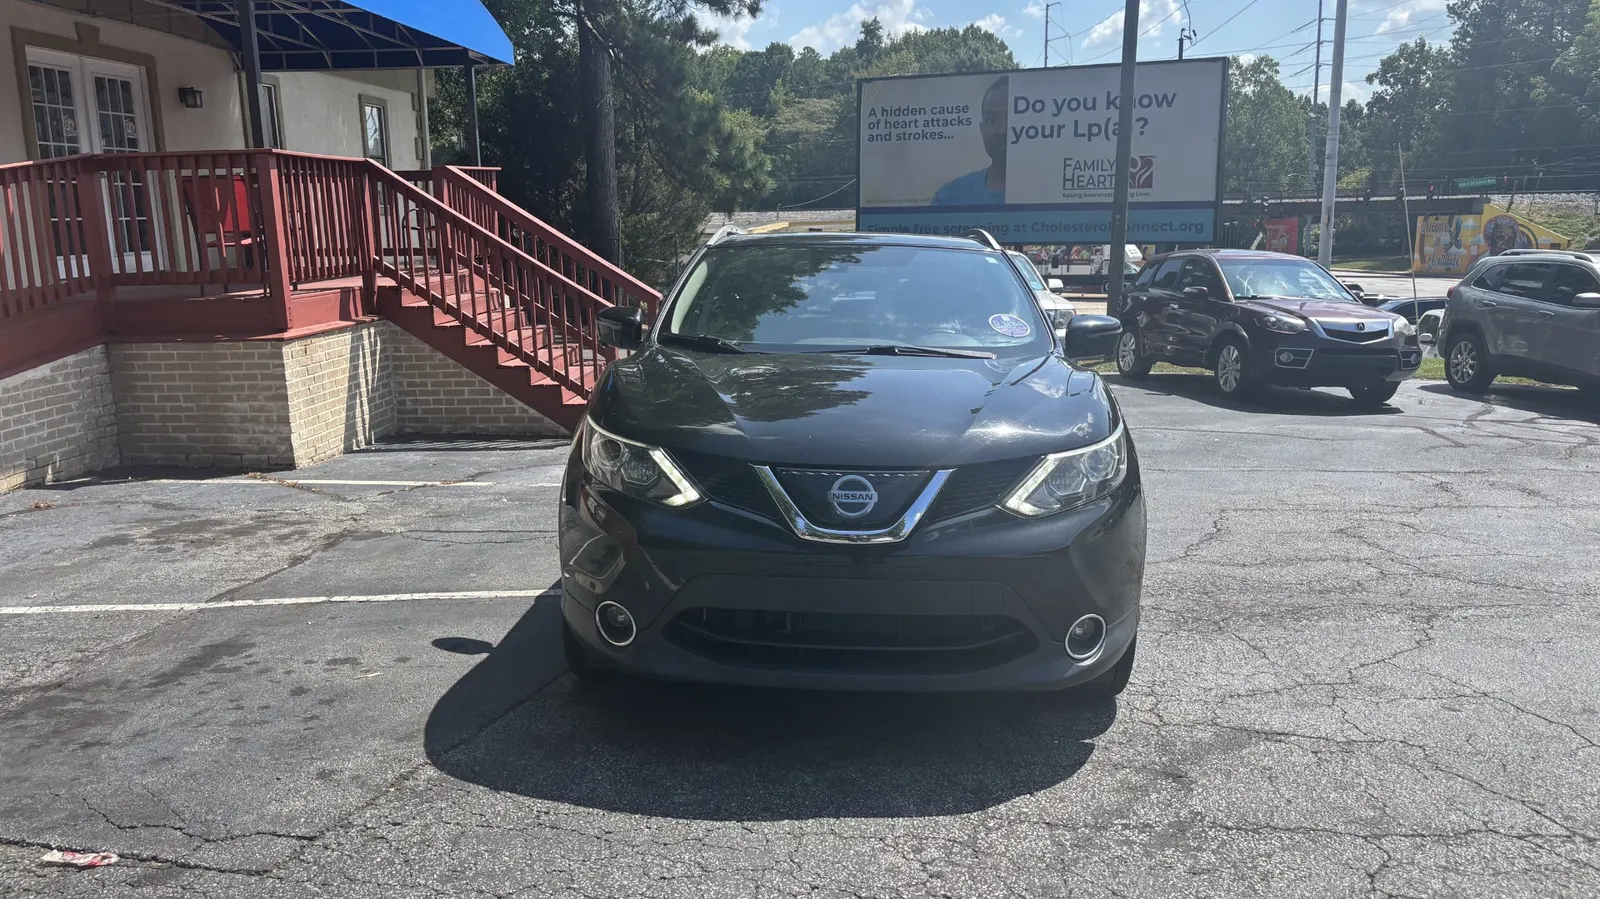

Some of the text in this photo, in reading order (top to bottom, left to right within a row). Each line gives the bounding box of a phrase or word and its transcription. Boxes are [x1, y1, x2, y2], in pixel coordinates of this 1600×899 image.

[868, 104, 970, 118] A hidden cause
[1013, 90, 1177, 117] Do you kow
[868, 115, 972, 130] of heart attacks
[868, 129, 954, 142] and strokes...
[1011, 117, 1149, 144] your Lp(a?
[1063, 157, 1116, 172] FAMILY
[1062, 172, 1116, 189] HEART
[914, 223, 940, 234] free
[1013, 223, 1027, 232] at
[1031, 221, 1203, 234] Cholesterolnnect.org
